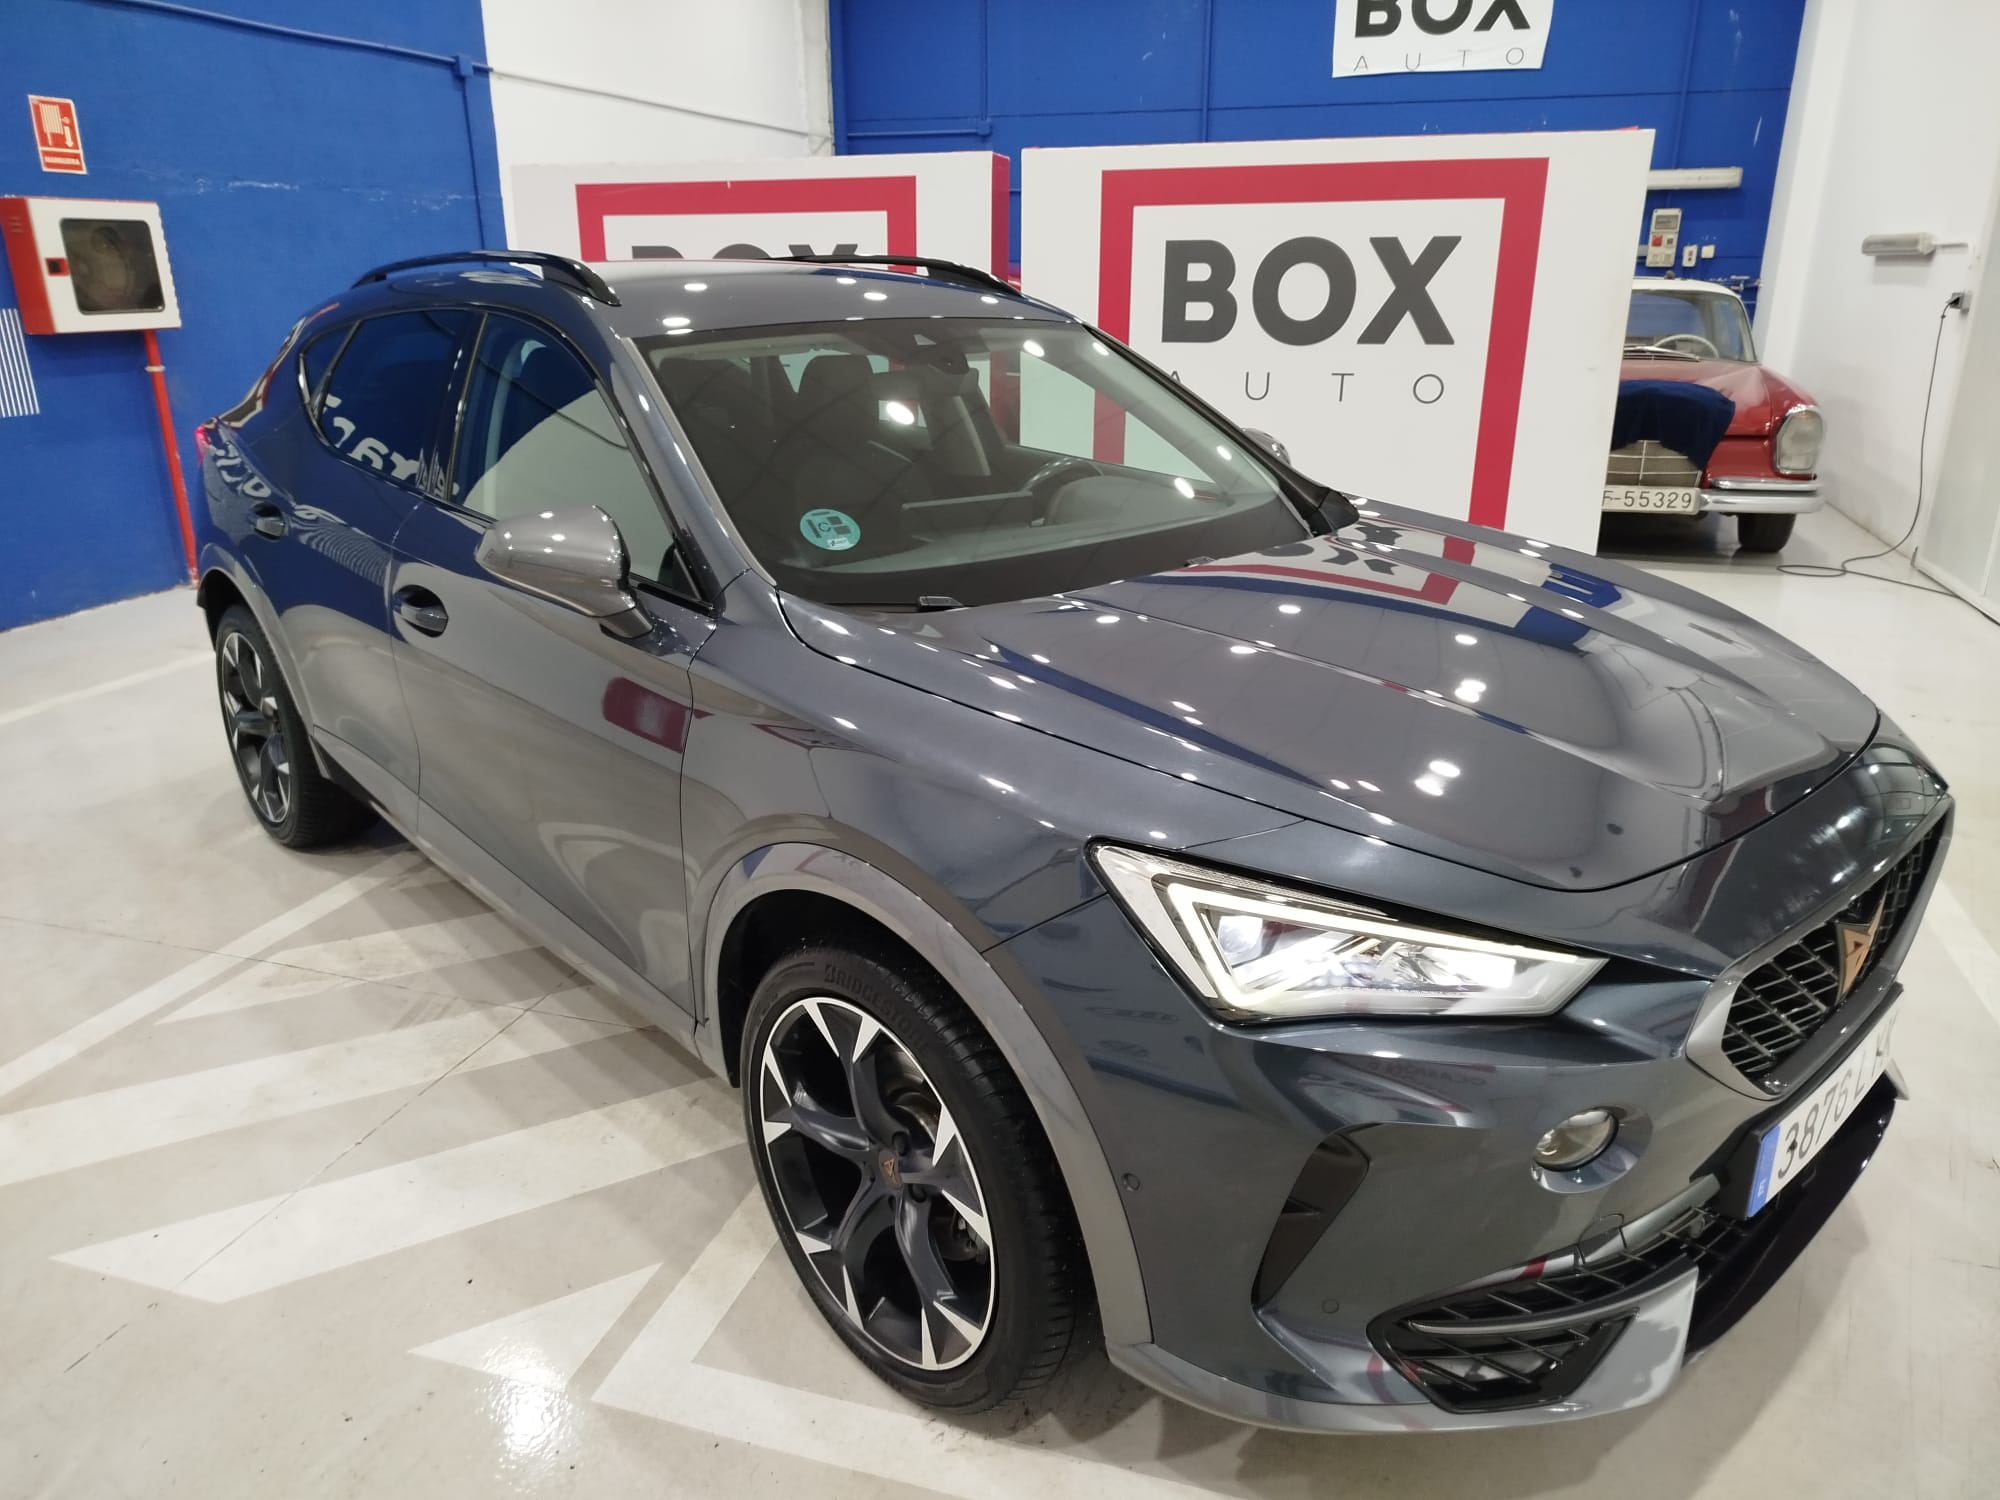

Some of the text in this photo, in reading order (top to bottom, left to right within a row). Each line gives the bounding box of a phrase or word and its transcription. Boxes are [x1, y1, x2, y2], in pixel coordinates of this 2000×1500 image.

[1353, 47, 1525, 71] AUTO
[1161, 234, 1462, 347] BOX
[1778, 1068, 1853, 1180] 3876
